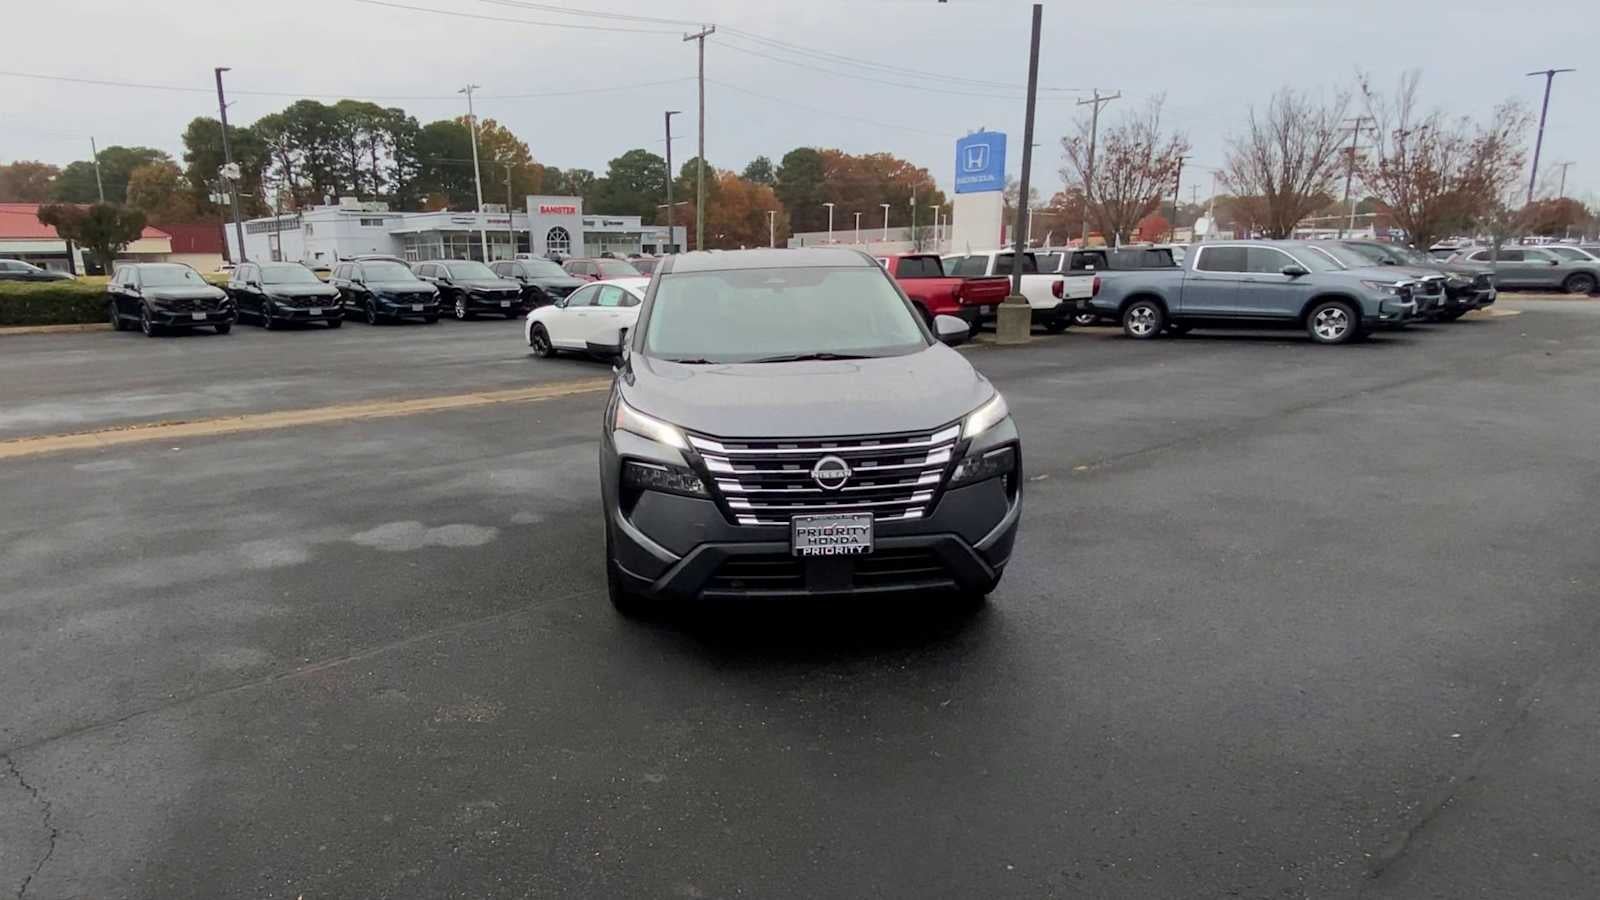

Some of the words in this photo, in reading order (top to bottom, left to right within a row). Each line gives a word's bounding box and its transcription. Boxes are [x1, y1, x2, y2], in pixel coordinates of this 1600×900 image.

[540, 205, 576, 216] BANISTER
[811, 469, 852, 479] NISSAN
[797, 527, 868, 537] PRIORITY
[808, 536, 859, 545] HONDA
[803, 546, 864, 556] PRIORITY
